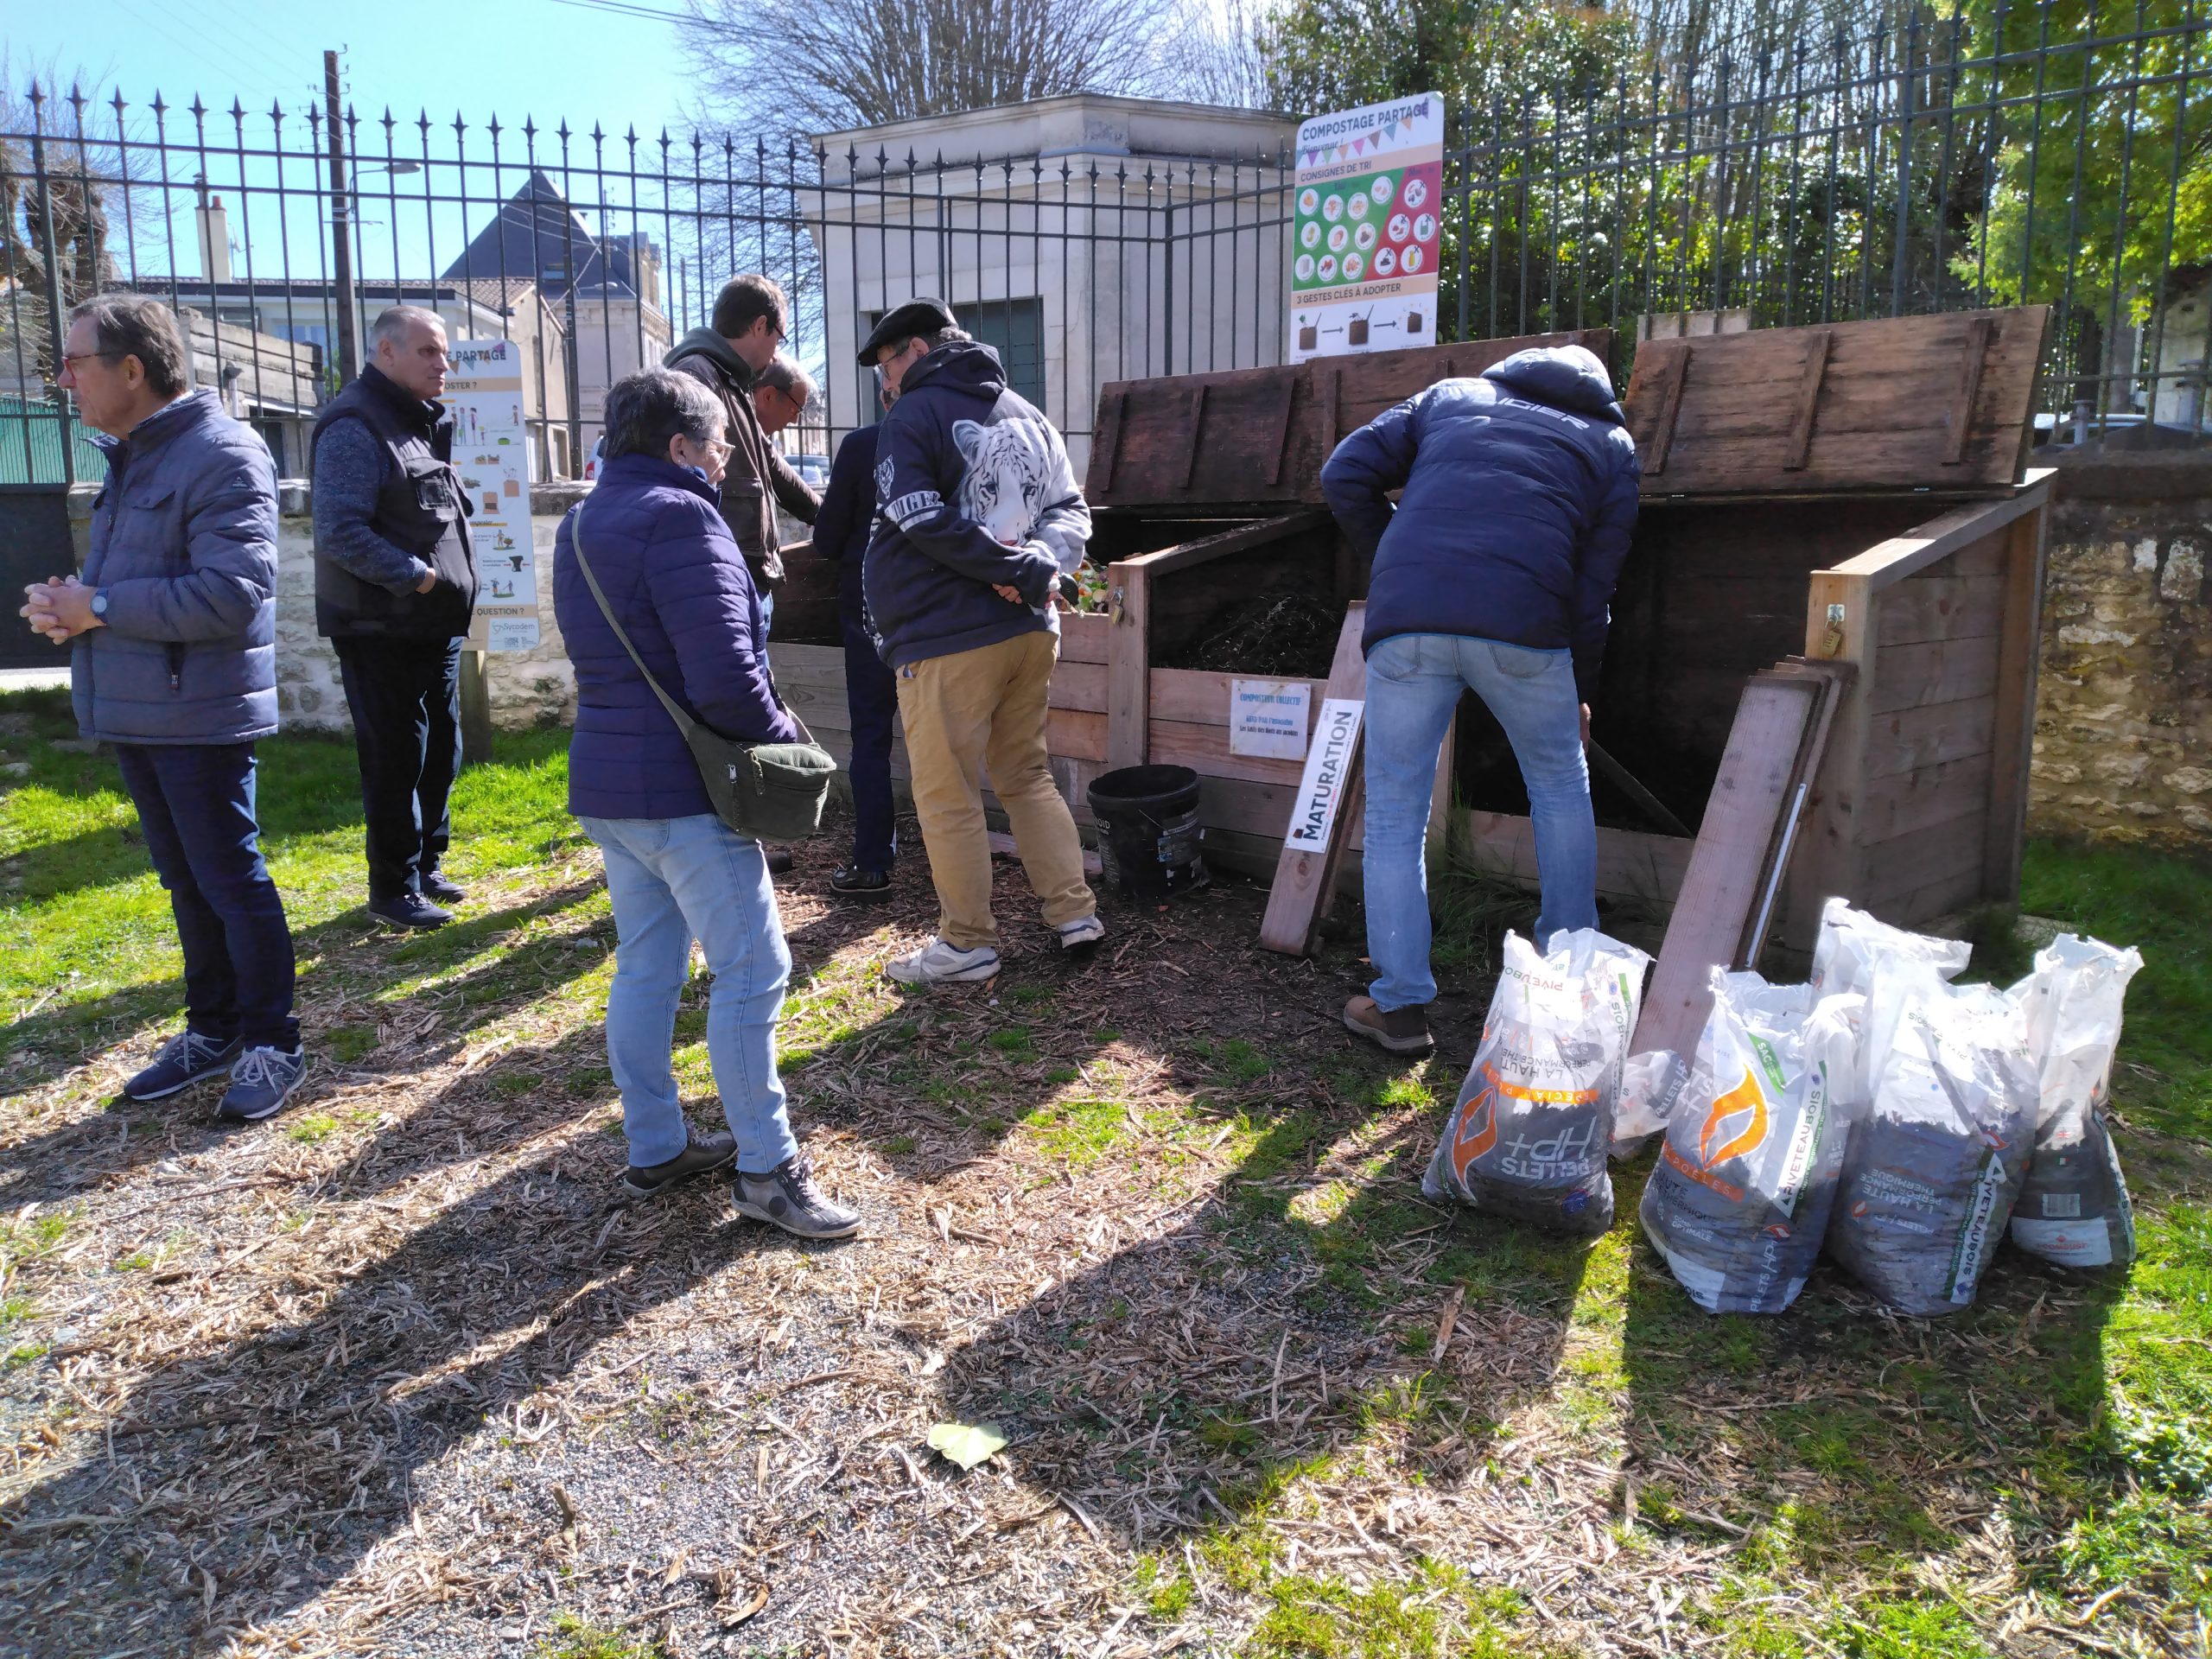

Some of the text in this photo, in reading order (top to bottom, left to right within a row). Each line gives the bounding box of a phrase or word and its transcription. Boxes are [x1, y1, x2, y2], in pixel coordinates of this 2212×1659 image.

[1302, 113, 1375, 141] COMPOSTAGE
[1300, 161, 1372, 182] CONSIGNES DE TRI
[1303, 292, 1332, 303] GESTES
[1334, 288, 1353, 299] CLÉS
[1355, 285, 1361, 297] À
[1363, 283, 1402, 296] ADOPTER
[476, 607, 518, 616] QUESTION
[503, 622, 535, 632] Sycodem
[1303, 711, 1353, 841] MATURATION
[1546, 1068, 1563, 1079] LA
[1504, 1115, 1596, 1161] HP+
[1783, 1090, 1821, 1196] PIVETEAUBOIS
[1501, 1156, 1591, 1180] PELLETS
[1859, 1173, 1942, 1206] PERFORMANCE
[1871, 1168, 1935, 1197] THERMIQUE
[1862, 1183, 1935, 1215] LA HAUTE
